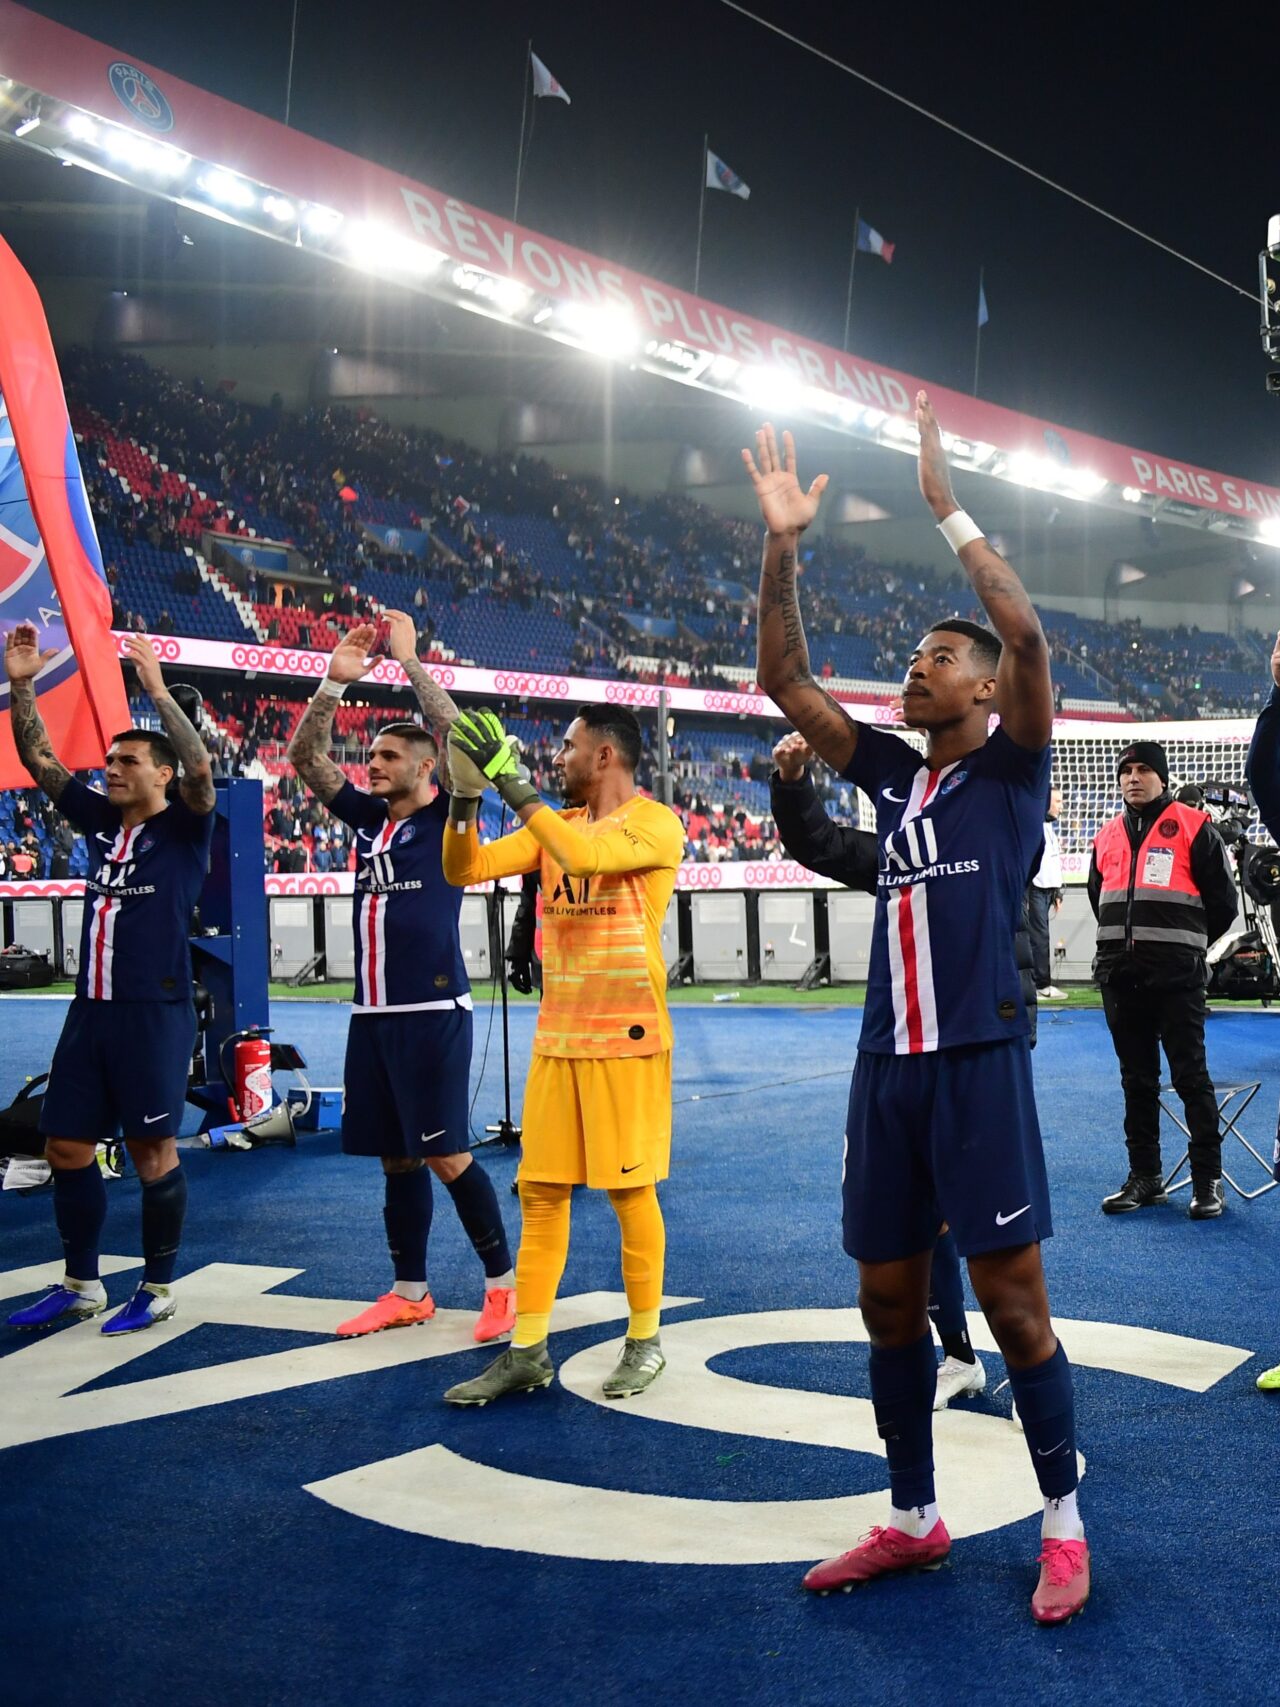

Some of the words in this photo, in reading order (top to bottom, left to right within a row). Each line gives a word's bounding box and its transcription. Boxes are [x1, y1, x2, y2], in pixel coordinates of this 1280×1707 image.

[400, 186, 631, 306] RÊVONS
[640, 285, 763, 363] PLUS
[770, 337, 911, 413] GRAND
[1131, 455, 1219, 505] PARIS
[231, 645, 327, 674] ooredoo
[372, 661, 455, 687] ooroo
[494, 674, 569, 697] ooredoo
[704, 693, 764, 714] ooredoo
[744, 864, 815, 885] ooredoo
[886, 874, 914, 886] LIVE
[378, 880, 423, 893] LIMITLESS
[556, 907, 577, 916] LIVE
